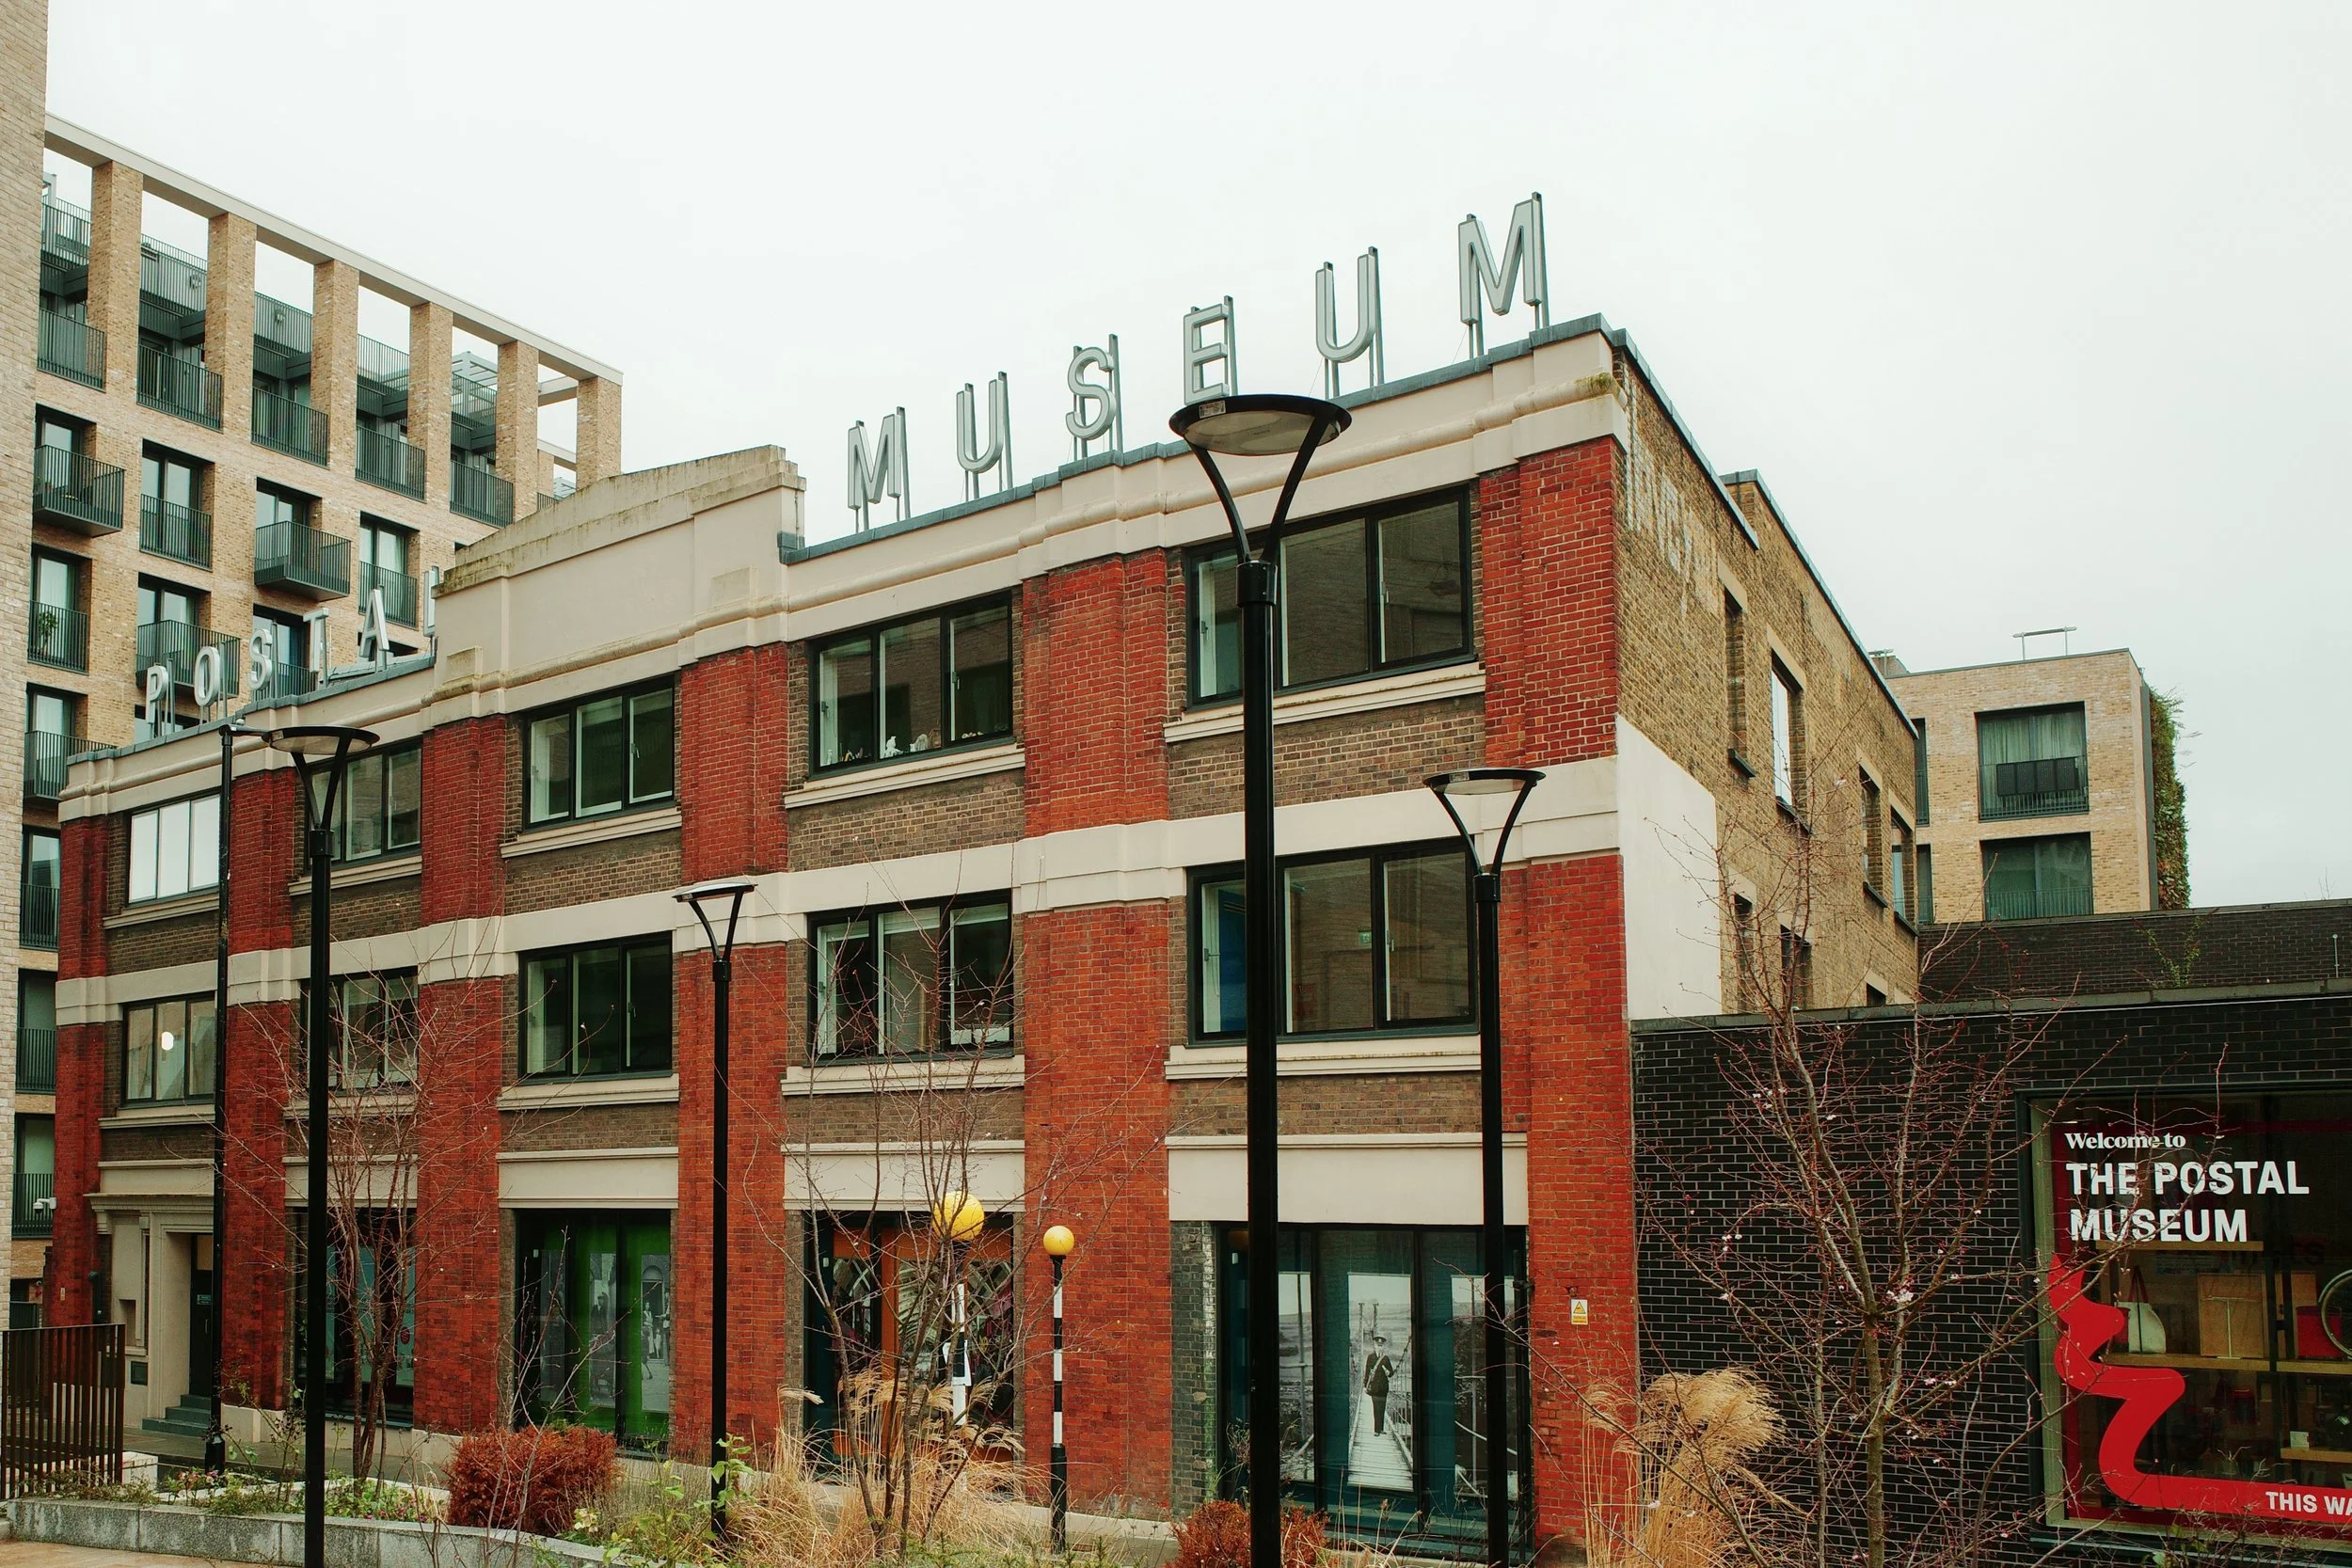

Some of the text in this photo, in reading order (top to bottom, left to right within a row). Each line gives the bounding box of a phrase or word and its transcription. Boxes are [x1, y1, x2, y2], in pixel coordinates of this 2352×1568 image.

[848, 196, 1543, 511] MUSEUM
[2064, 1132, 2186, 1149] Welcome to
[2065, 1160, 2310, 1196] THE POSTAL
[2070, 1209, 2248, 1243] MUSEUM
[2265, 1491, 2318, 1513] THIS
